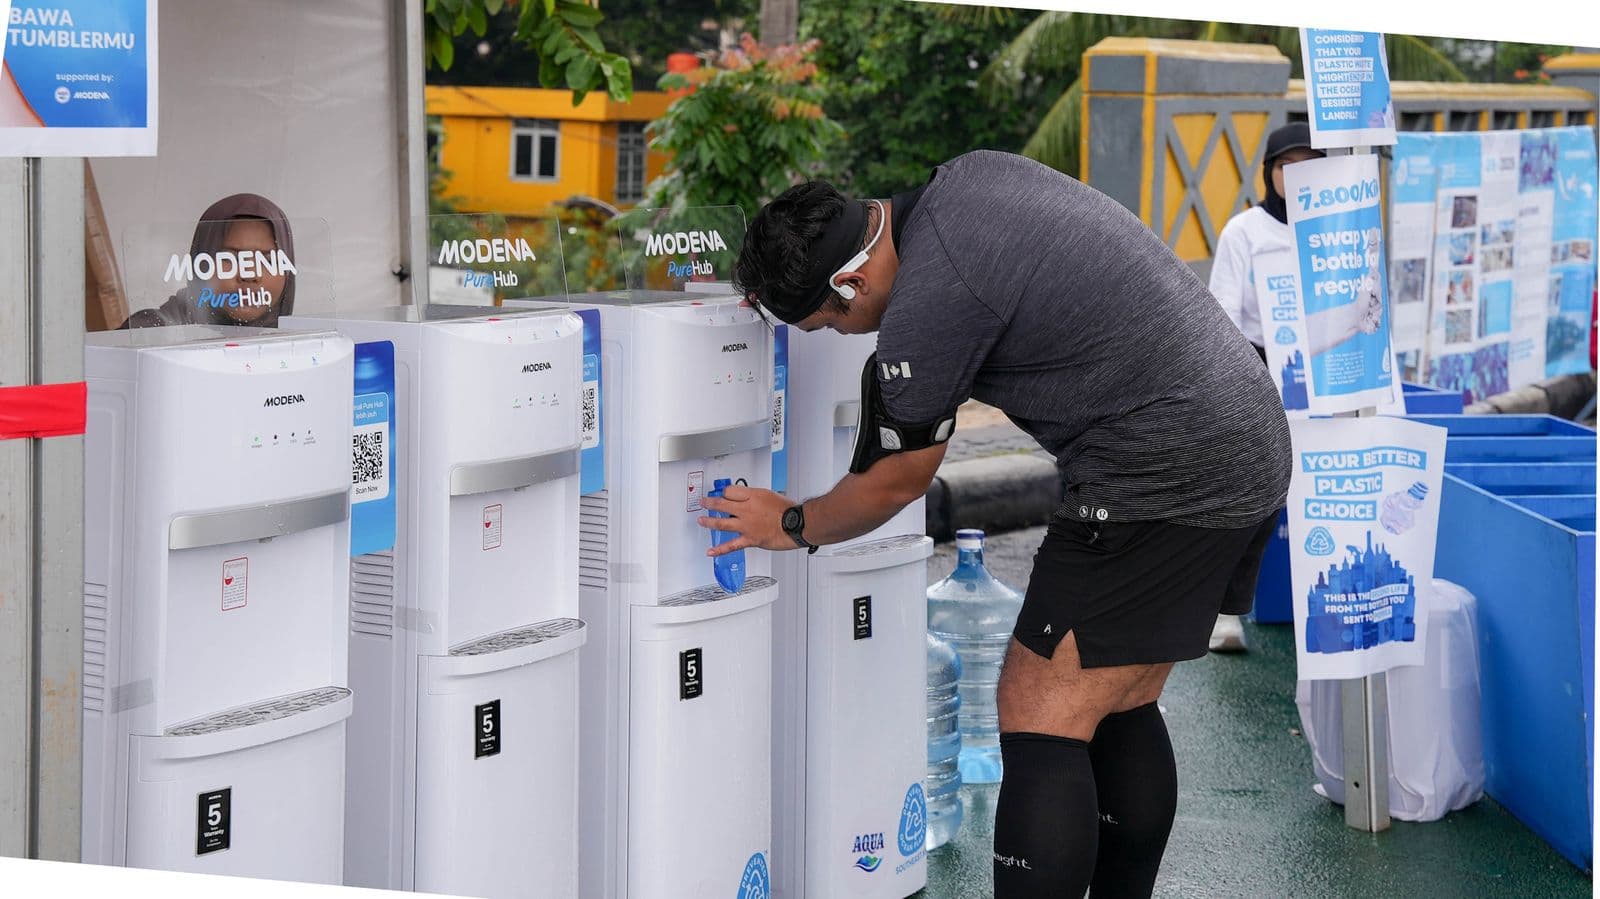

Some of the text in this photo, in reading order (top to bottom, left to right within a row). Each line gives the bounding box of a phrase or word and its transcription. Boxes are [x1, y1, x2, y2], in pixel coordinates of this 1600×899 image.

[9, 8, 73, 26] BAWA
[8, 29, 135, 49] TUMBLERMU
[1316, 48, 1342, 56] THAT
[1317, 60, 1354, 69] PLASTIC
[56, 73, 114, 83] supported by:
[1319, 73, 1350, 82] MIGHT
[1320, 86, 1338, 94] THE
[645, 230, 727, 257] MODENA
[1308, 230, 1360, 250] swap
[438, 238, 536, 265] MODENA
[163, 249, 298, 283] MODENA
[667, 259, 713, 278] PureHub
[463, 270, 518, 288] PureHub
[197, 287, 273, 309] PureHub
[722, 343, 748, 352] MODENA
[521, 362, 552, 373] MODENA
[264, 394, 305, 407] MODENA
[1304, 450, 1421, 470] YOUR BETTER
[355, 484, 378, 495] Scan Now
[1317, 476, 1382, 493] PLASTIC
[1306, 502, 1374, 519] CHOICE
[1323, 593, 1346, 602] THIS
[1347, 593, 1357, 602] IS
[1324, 604, 1353, 614] FROM
[1390, 596, 1405, 605] YOU
[859, 605, 867, 621] 5
[1343, 614, 1364, 625] SENT
[687, 660, 697, 677] 5
[483, 713, 493, 733] 5
[208, 803, 222, 826] 5
[852, 832, 884, 854] AQUA
